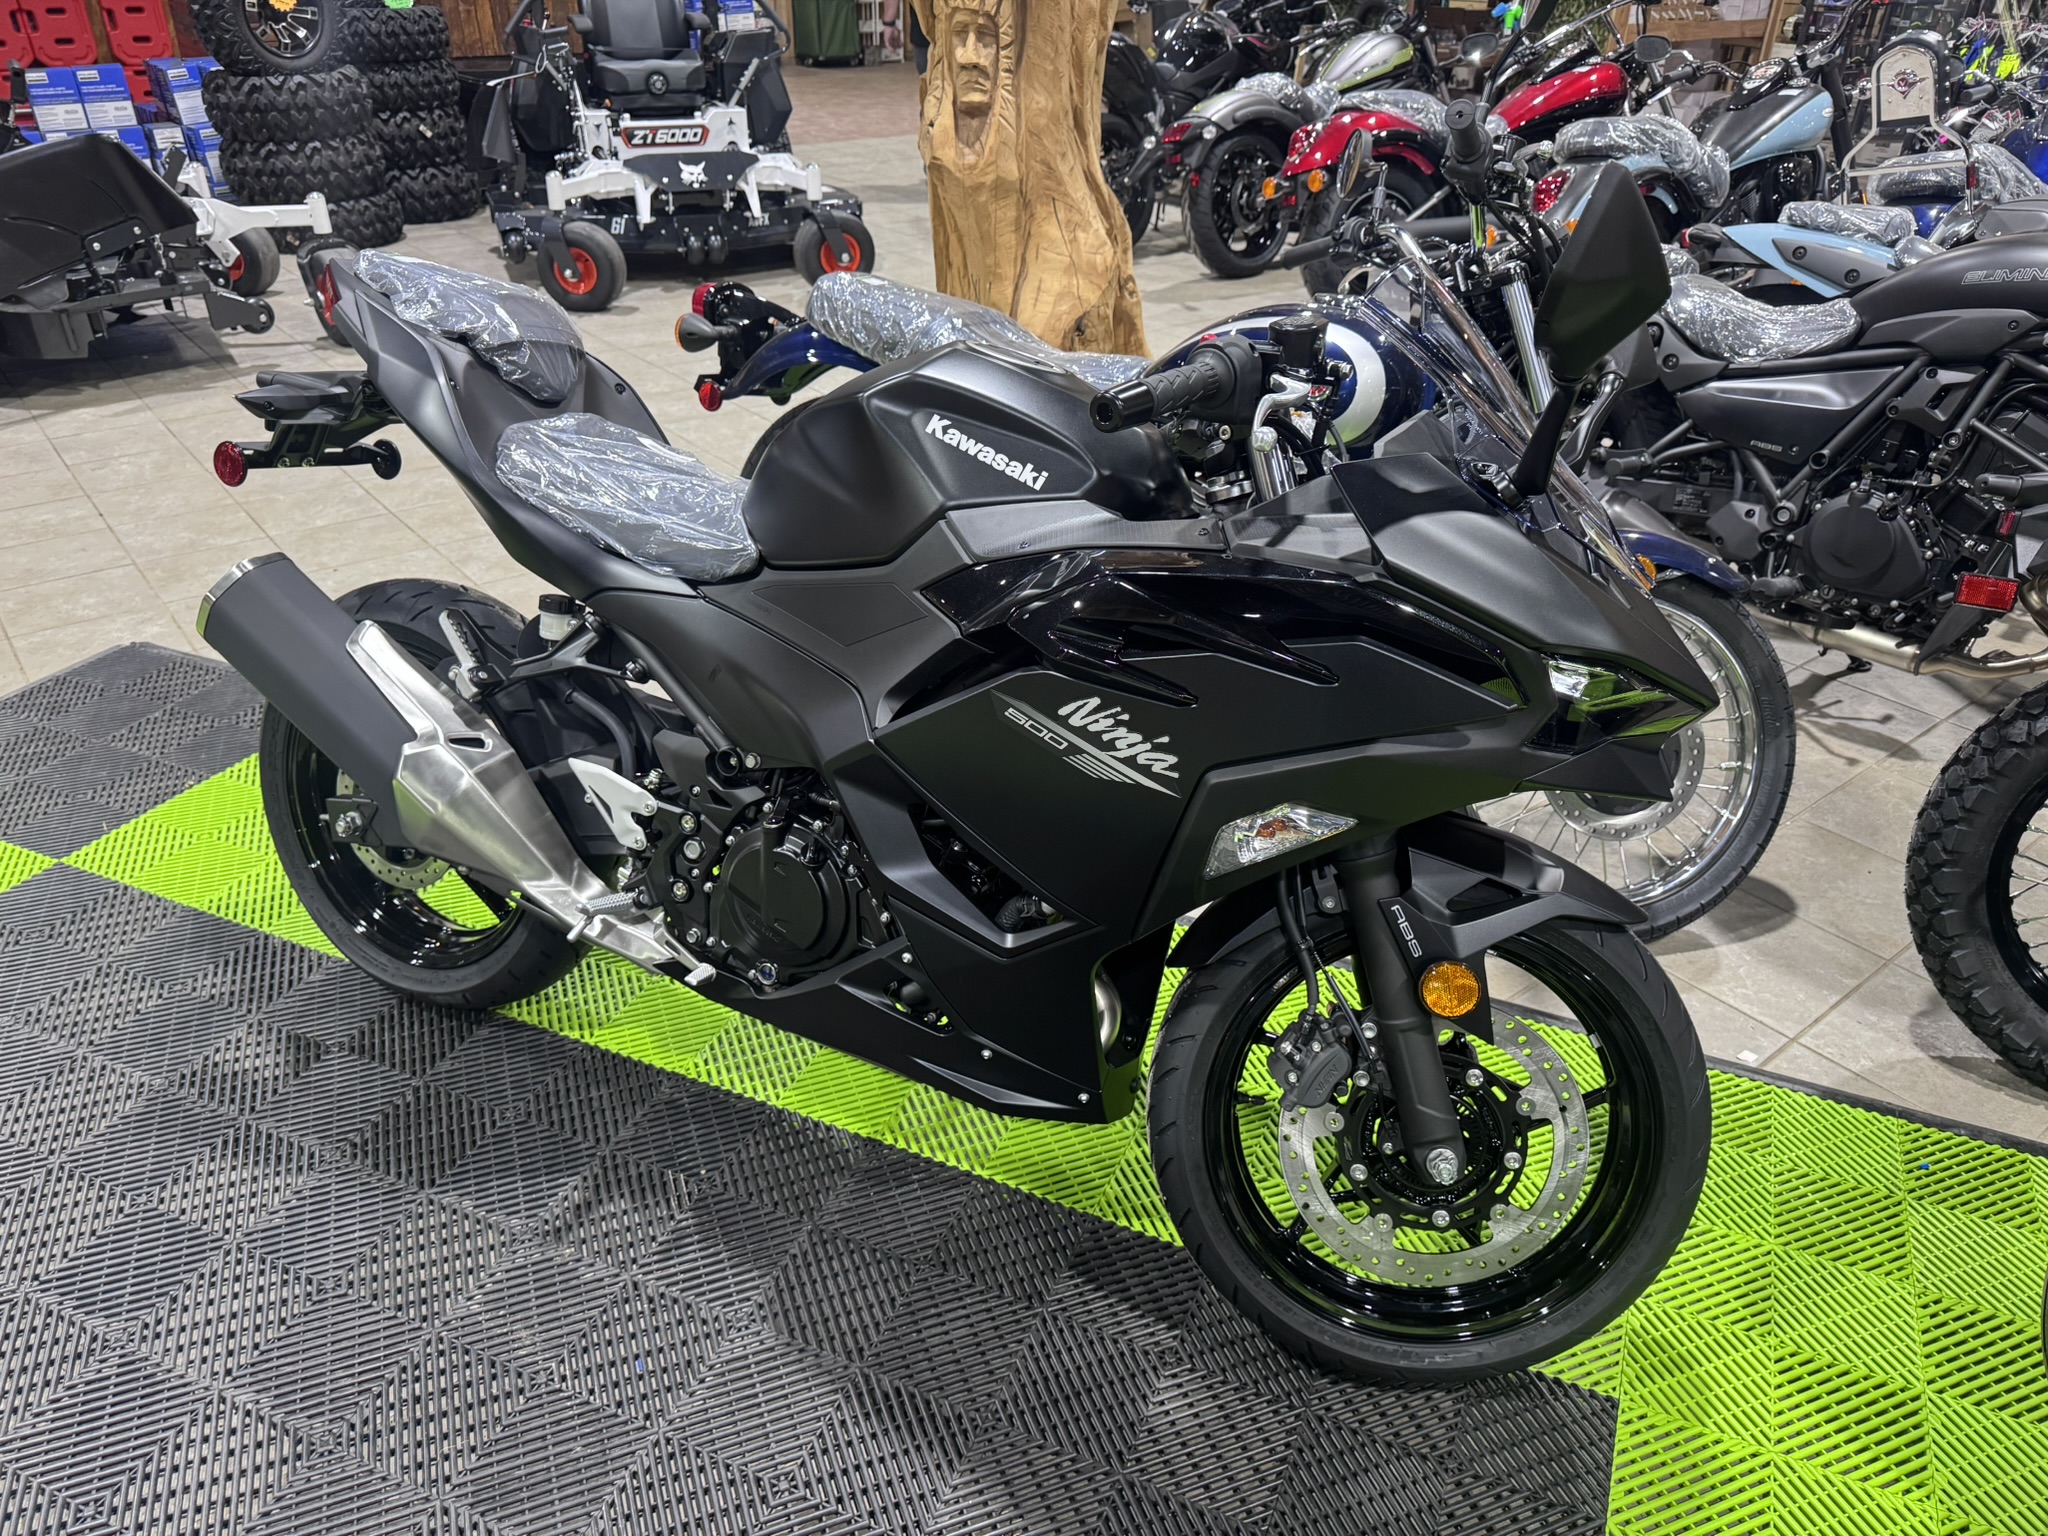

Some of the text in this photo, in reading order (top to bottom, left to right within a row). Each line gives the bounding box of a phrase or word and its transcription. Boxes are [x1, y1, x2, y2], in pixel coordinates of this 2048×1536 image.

[631, 127, 704, 145] ZT6000
[610, 216, 627, 235] 61
[925, 414, 1049, 491] Kawasaki
[1749, 439, 1783, 453] ABS
[1004, 707, 1069, 751] 500
[1057, 697, 1180, 778] Ninja
[1391, 904, 1423, 958] ABS
